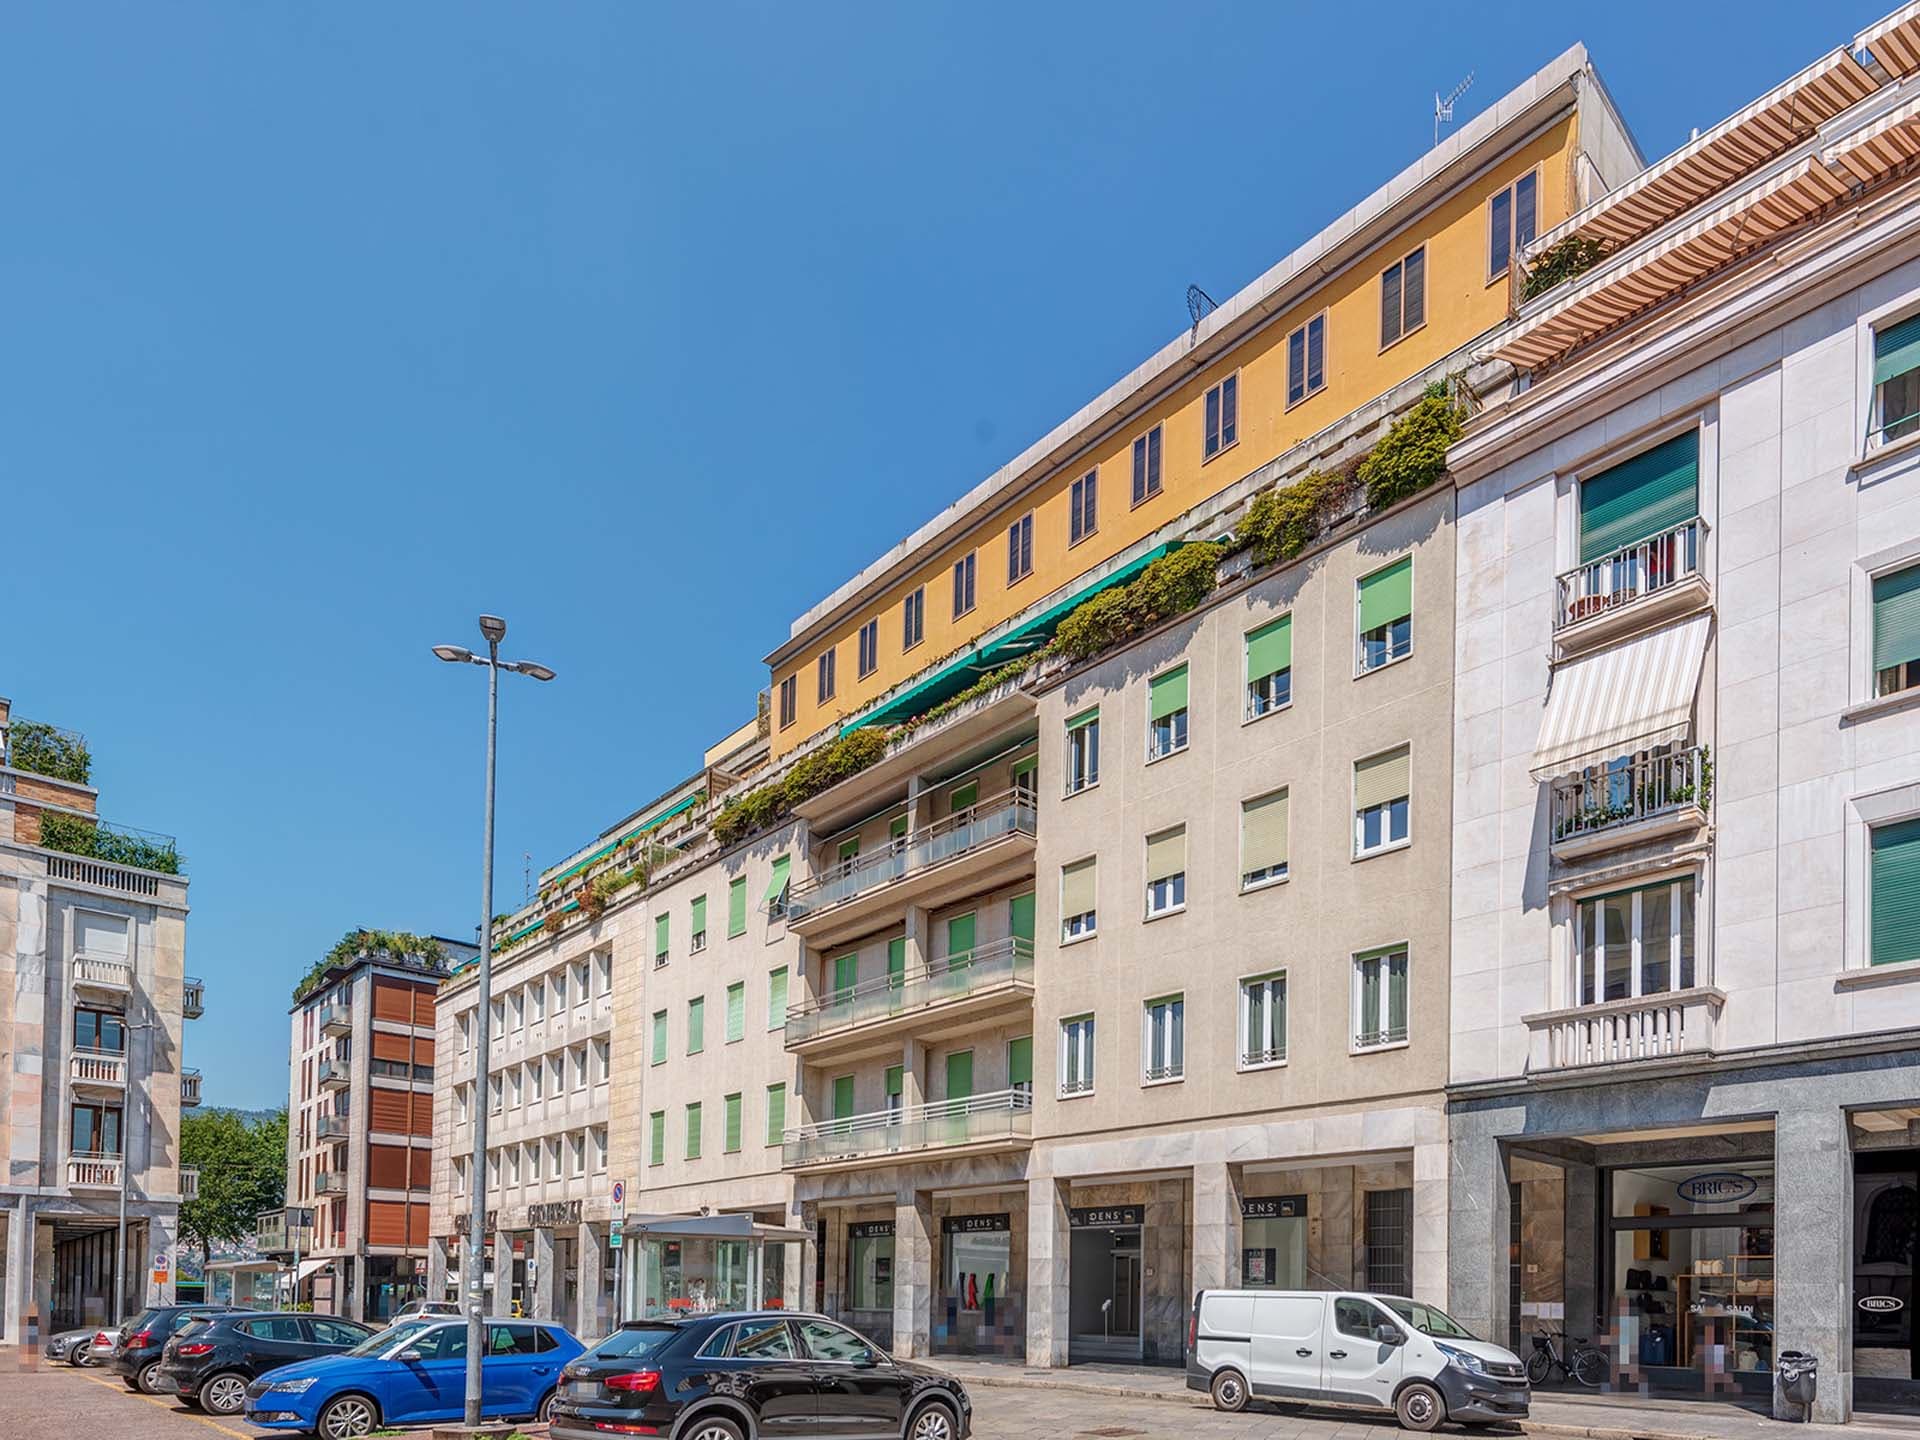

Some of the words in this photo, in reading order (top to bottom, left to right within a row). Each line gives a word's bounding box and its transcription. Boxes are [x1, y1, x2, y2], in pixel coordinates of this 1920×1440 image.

[1089, 1211, 1119, 1221] DENS
[966, 1218, 991, 1228] DENS
[1726, 1304, 1754, 1313] SALDI
